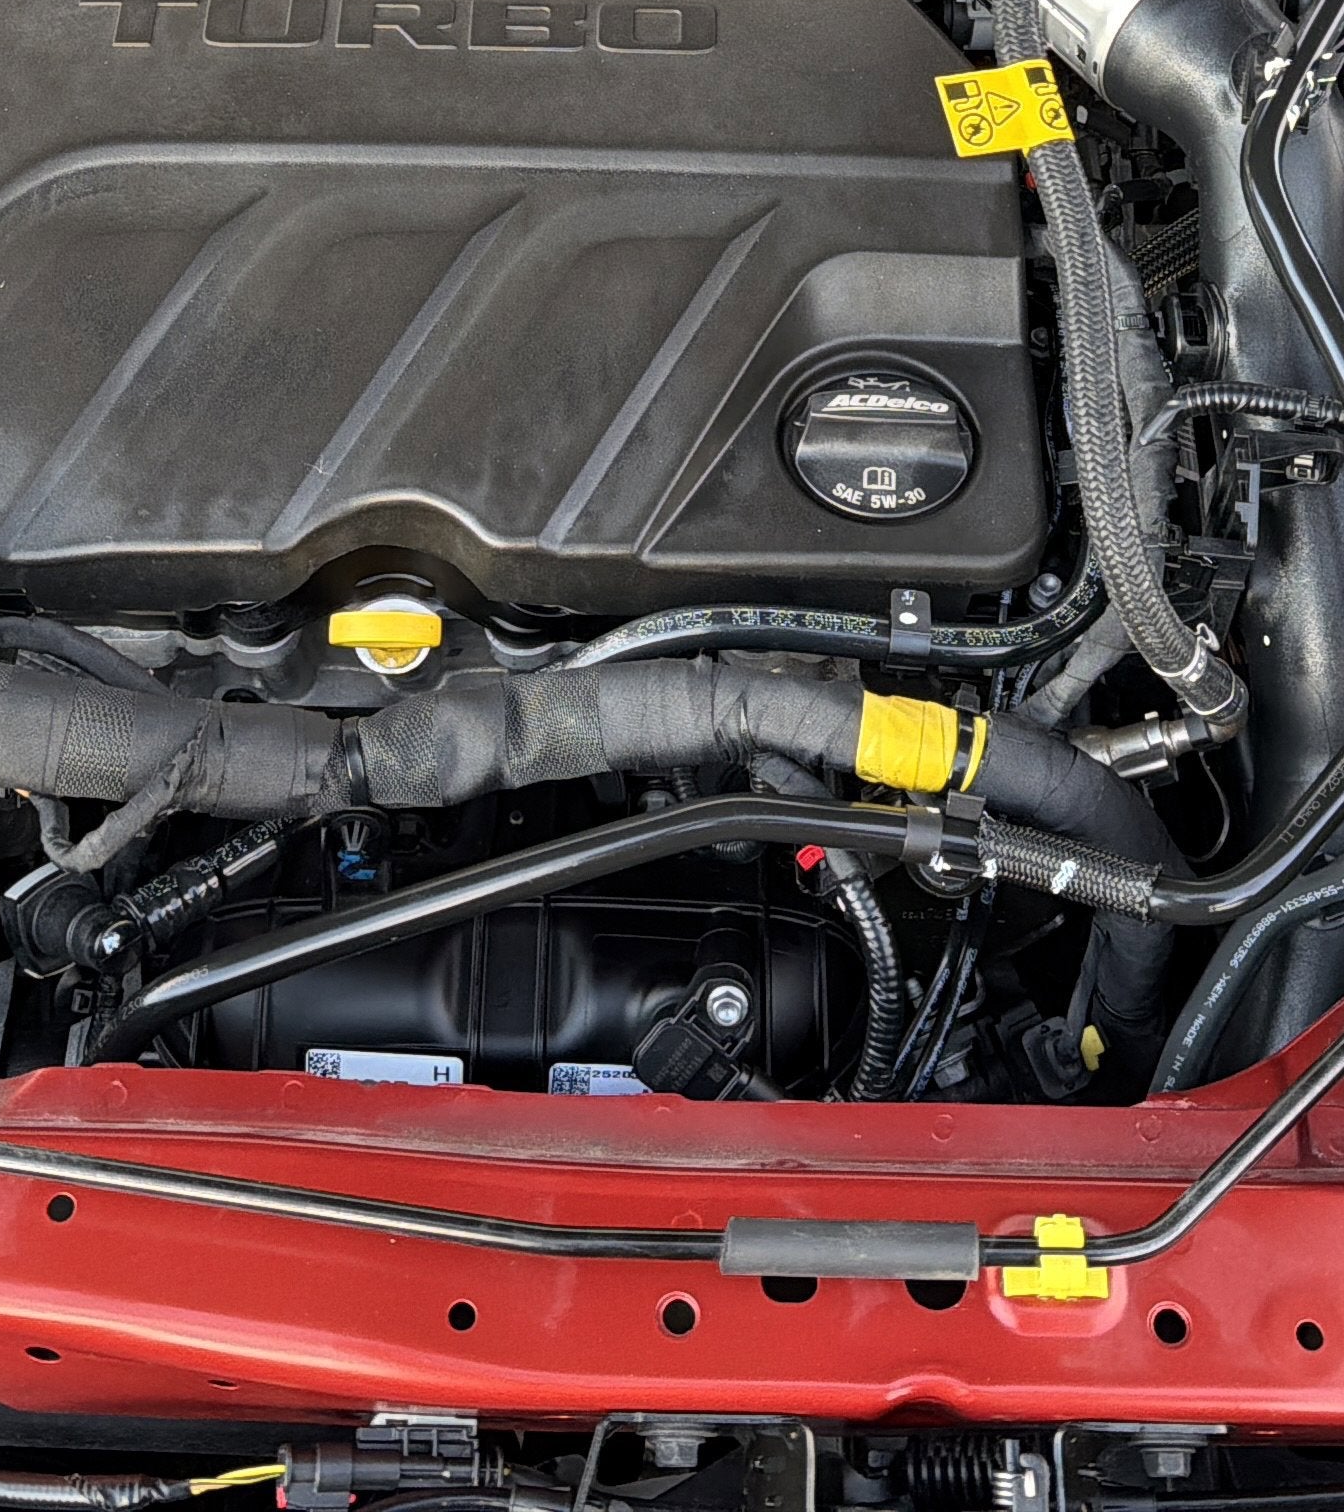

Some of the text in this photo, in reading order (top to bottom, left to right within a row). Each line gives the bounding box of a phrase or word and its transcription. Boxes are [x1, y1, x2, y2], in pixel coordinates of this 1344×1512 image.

[827, 393, 949, 414] ACDelco
[831, 483, 926, 509] SAE 5W-30
[1180, 1012, 1206, 1049] MADE
[1170, 1053, 1185, 1072] IN
[433, 1065, 451, 1082] H
